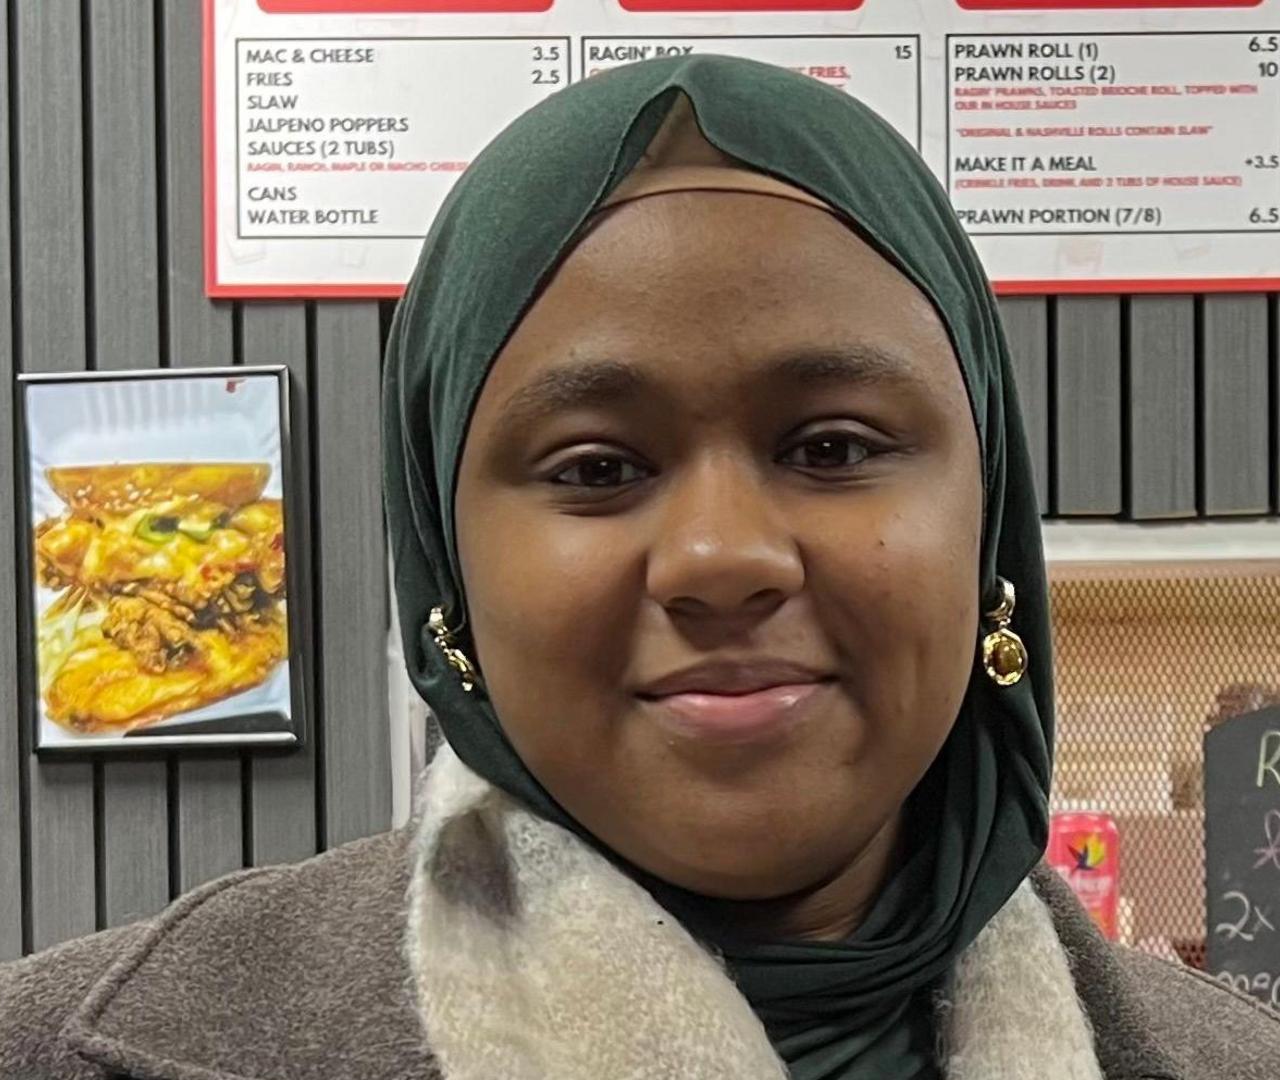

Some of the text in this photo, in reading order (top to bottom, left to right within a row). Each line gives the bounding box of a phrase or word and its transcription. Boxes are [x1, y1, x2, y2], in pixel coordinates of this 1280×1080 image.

[954, 43, 1099, 61] PRAWN ROLL (1)
[1248, 36, 1279, 52] 6.5
[246, 48, 375, 64] MAC & CHEESE
[532, 46, 560, 61] 3.5
[894, 46, 913, 60] 15
[531, 70, 561, 85] 2.5
[954, 65, 1116, 84] PRAWN ROLLS (2)
[1258, 62, 1279, 78] 10
[247, 72, 294, 87] FRIES
[247, 95, 299, 110] SLAW
[247, 117, 410, 133] JALPENO POPPERS
[247, 140, 395, 158] SAUCES (2 TUBS)
[955, 156, 1097, 172] MAKE IT A MEAL
[1245, 155, 1280, 170] +3.5
[247, 186, 298, 202] CANS
[247, 209, 380, 225] WATER BOTTLE
[957, 207, 1162, 227] PRAWN PORTION (7/8)
[1249, 208, 1280, 224] 6.5
